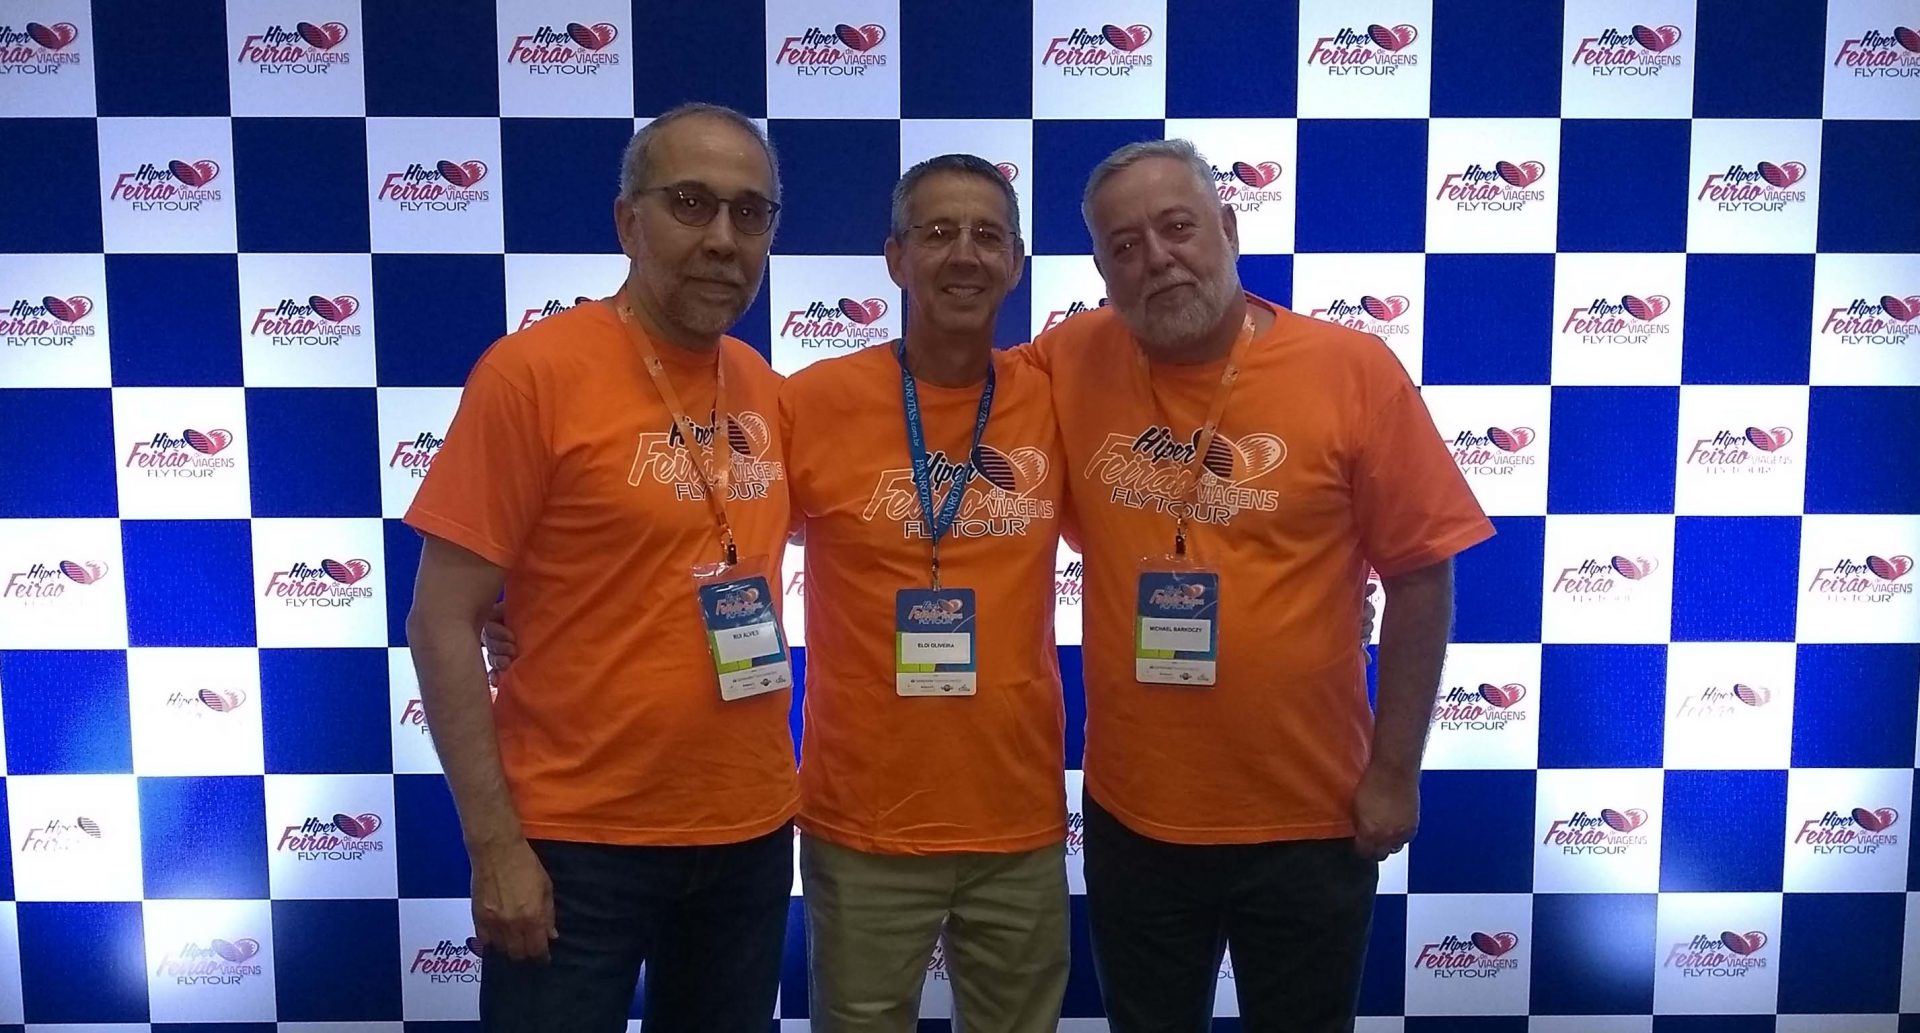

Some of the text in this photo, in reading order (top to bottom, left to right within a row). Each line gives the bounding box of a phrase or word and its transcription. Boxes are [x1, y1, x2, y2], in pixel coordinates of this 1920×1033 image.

[263, 26, 301, 46] Hiper
[533, 26, 571, 47] Hiper
[801, 27, 839, 48] Hiper
[1068, 28, 1106, 48] Hiper
[1334, 28, 1371, 49] Hiper
[1598, 28, 1635, 49] Hiper
[1862, 29, 1898, 49] Hiper
[35, 52, 79, 62] VIAGENS
[238, 36, 350, 63] Feirão VIAGENS
[507, 36, 619, 64] Feirão VIAGENS
[775, 37, 887, 65] Feirão VIAGENS
[1042, 37, 1153, 65] Feirão VIAGENS
[1308, 38, 1417, 65] Feirão VIAGENS
[1572, 38, 1681, 66] Feirão VIAGENS
[1836, 38, 1902, 66] Feirão
[0, 64, 56, 72] LYTOUR
[260, 65, 327, 74] FLYTOUR
[530, 66, 596, 74] FLYTOUR
[797, 66, 864, 75] FLYTOUR
[1064, 66, 1130, 75] FLYTOUR
[1329, 67, 1394, 76] FLYTOUR
[1593, 67, 1658, 76] FLYTOUR
[135, 164, 173, 184] Hiper
[403, 164, 441, 184] Hiper
[1462, 165, 1499, 185] Hiper
[1724, 165, 1760, 185] Hiper
[110, 173, 221, 201] Feirão VIAGENS
[378, 174, 489, 201] Feirão VIAGENS
[1240, 191, 1283, 201] VIAGENS
[1436, 174, 1545, 201] Feirão VIAGENS
[1698, 174, 1806, 201] Feirão VIAGENS
[133, 202, 199, 211] FLYTOUR
[400, 202, 466, 211] FLYTOUR
[1457, 202, 1522, 211] FLYTOUR
[1719, 202, 1783, 211] FLYTOUR
[9, 299, 46, 319] Hiper
[276, 299, 313, 319] Hiper
[806, 301, 843, 321] Hiper
[1328, 298, 1365, 318] Hiper
[1588, 298, 1624, 318] Hiper
[1847, 298, 1884, 318] Hiper
[0, 309, 95, 335] eirão VIAGENS
[251, 309, 361, 335] Feirão VIAGENS
[780, 310, 890, 337] Feirão VIAGENS
[1368, 324, 1410, 334] VIAGENS
[1563, 308, 1670, 334] Feirão VIAGENS
[1822, 308, 1920, 334] Feirão VIAGEN
[7, 337, 73, 346] FLYTOUR
[273, 337, 338, 346] FLYTOUR
[802, 338, 867, 347] FLYTOUR
[1583, 336, 1647, 344] FLYTOUR
[1842, 336, 1905, 344] FLYTOUR
[150, 432, 187, 452] Hiper
[413, 432, 444, 451] Hipe
[1131, 426, 1197, 464] Hiper
[1454, 430, 1490, 449] Hiper
[1712, 430, 1748, 449] Hiper
[125, 442, 235, 468] Feirão VIAGENS
[1494, 455, 1536, 465] VIAGENS
[1686, 439, 1752, 465] Feirão
[1462, 466, 1513, 475] YTOUR
[675, 482, 768, 501] FLYOUR
[1197, 485, 1279, 511] VIAGENS
[987, 498, 1054, 518] VIAGENS
[905, 519, 1026, 538] FLTOUR
[288, 562, 325, 582] Hiper
[1578, 559, 1614, 578] Hiper
[1833, 559, 1869, 578] Hiper
[264, 571, 372, 597] Feirão VIAGENS
[1808, 568, 1913, 593] Feirão VIAGENS
[286, 598, 350, 607] FLYTOUR
[1446, 686, 1482, 705] Hiper
[1434, 695, 1527, 720] eirão VIAGENS
[1442, 721, 1504, 729] FLYTOUR
[301, 816, 337, 835] Hiper
[1568, 812, 1604, 830] Hiper
[1820, 812, 1855, 830] Hiper
[277, 825, 384, 850] Feirão VIAGENS
[1544, 820, 1648, 845] Feirão VIAGENS
[1795, 821, 1898, 845] Feirão VIAGENS
[299, 851, 362, 859] FLYTOUR
[1564, 846, 1626, 854] FLYTOUR
[434, 940, 470, 958] Hiper
[1439, 936, 1474, 954] Hiper
[1688, 936, 1723, 954] Hiper
[410, 949, 475, 973] Feirão
[1415, 944, 1518, 968] Feirão VIAGENS
[1664, 944, 1766, 969] Feirão VIAGENS
[179, 976, 241, 984] FLYTOUR
[432, 974, 481, 982] FLYTOU
[1435, 970, 1496, 978] FLYTOUR
[1684, 970, 1745, 978] FLYTOUR
